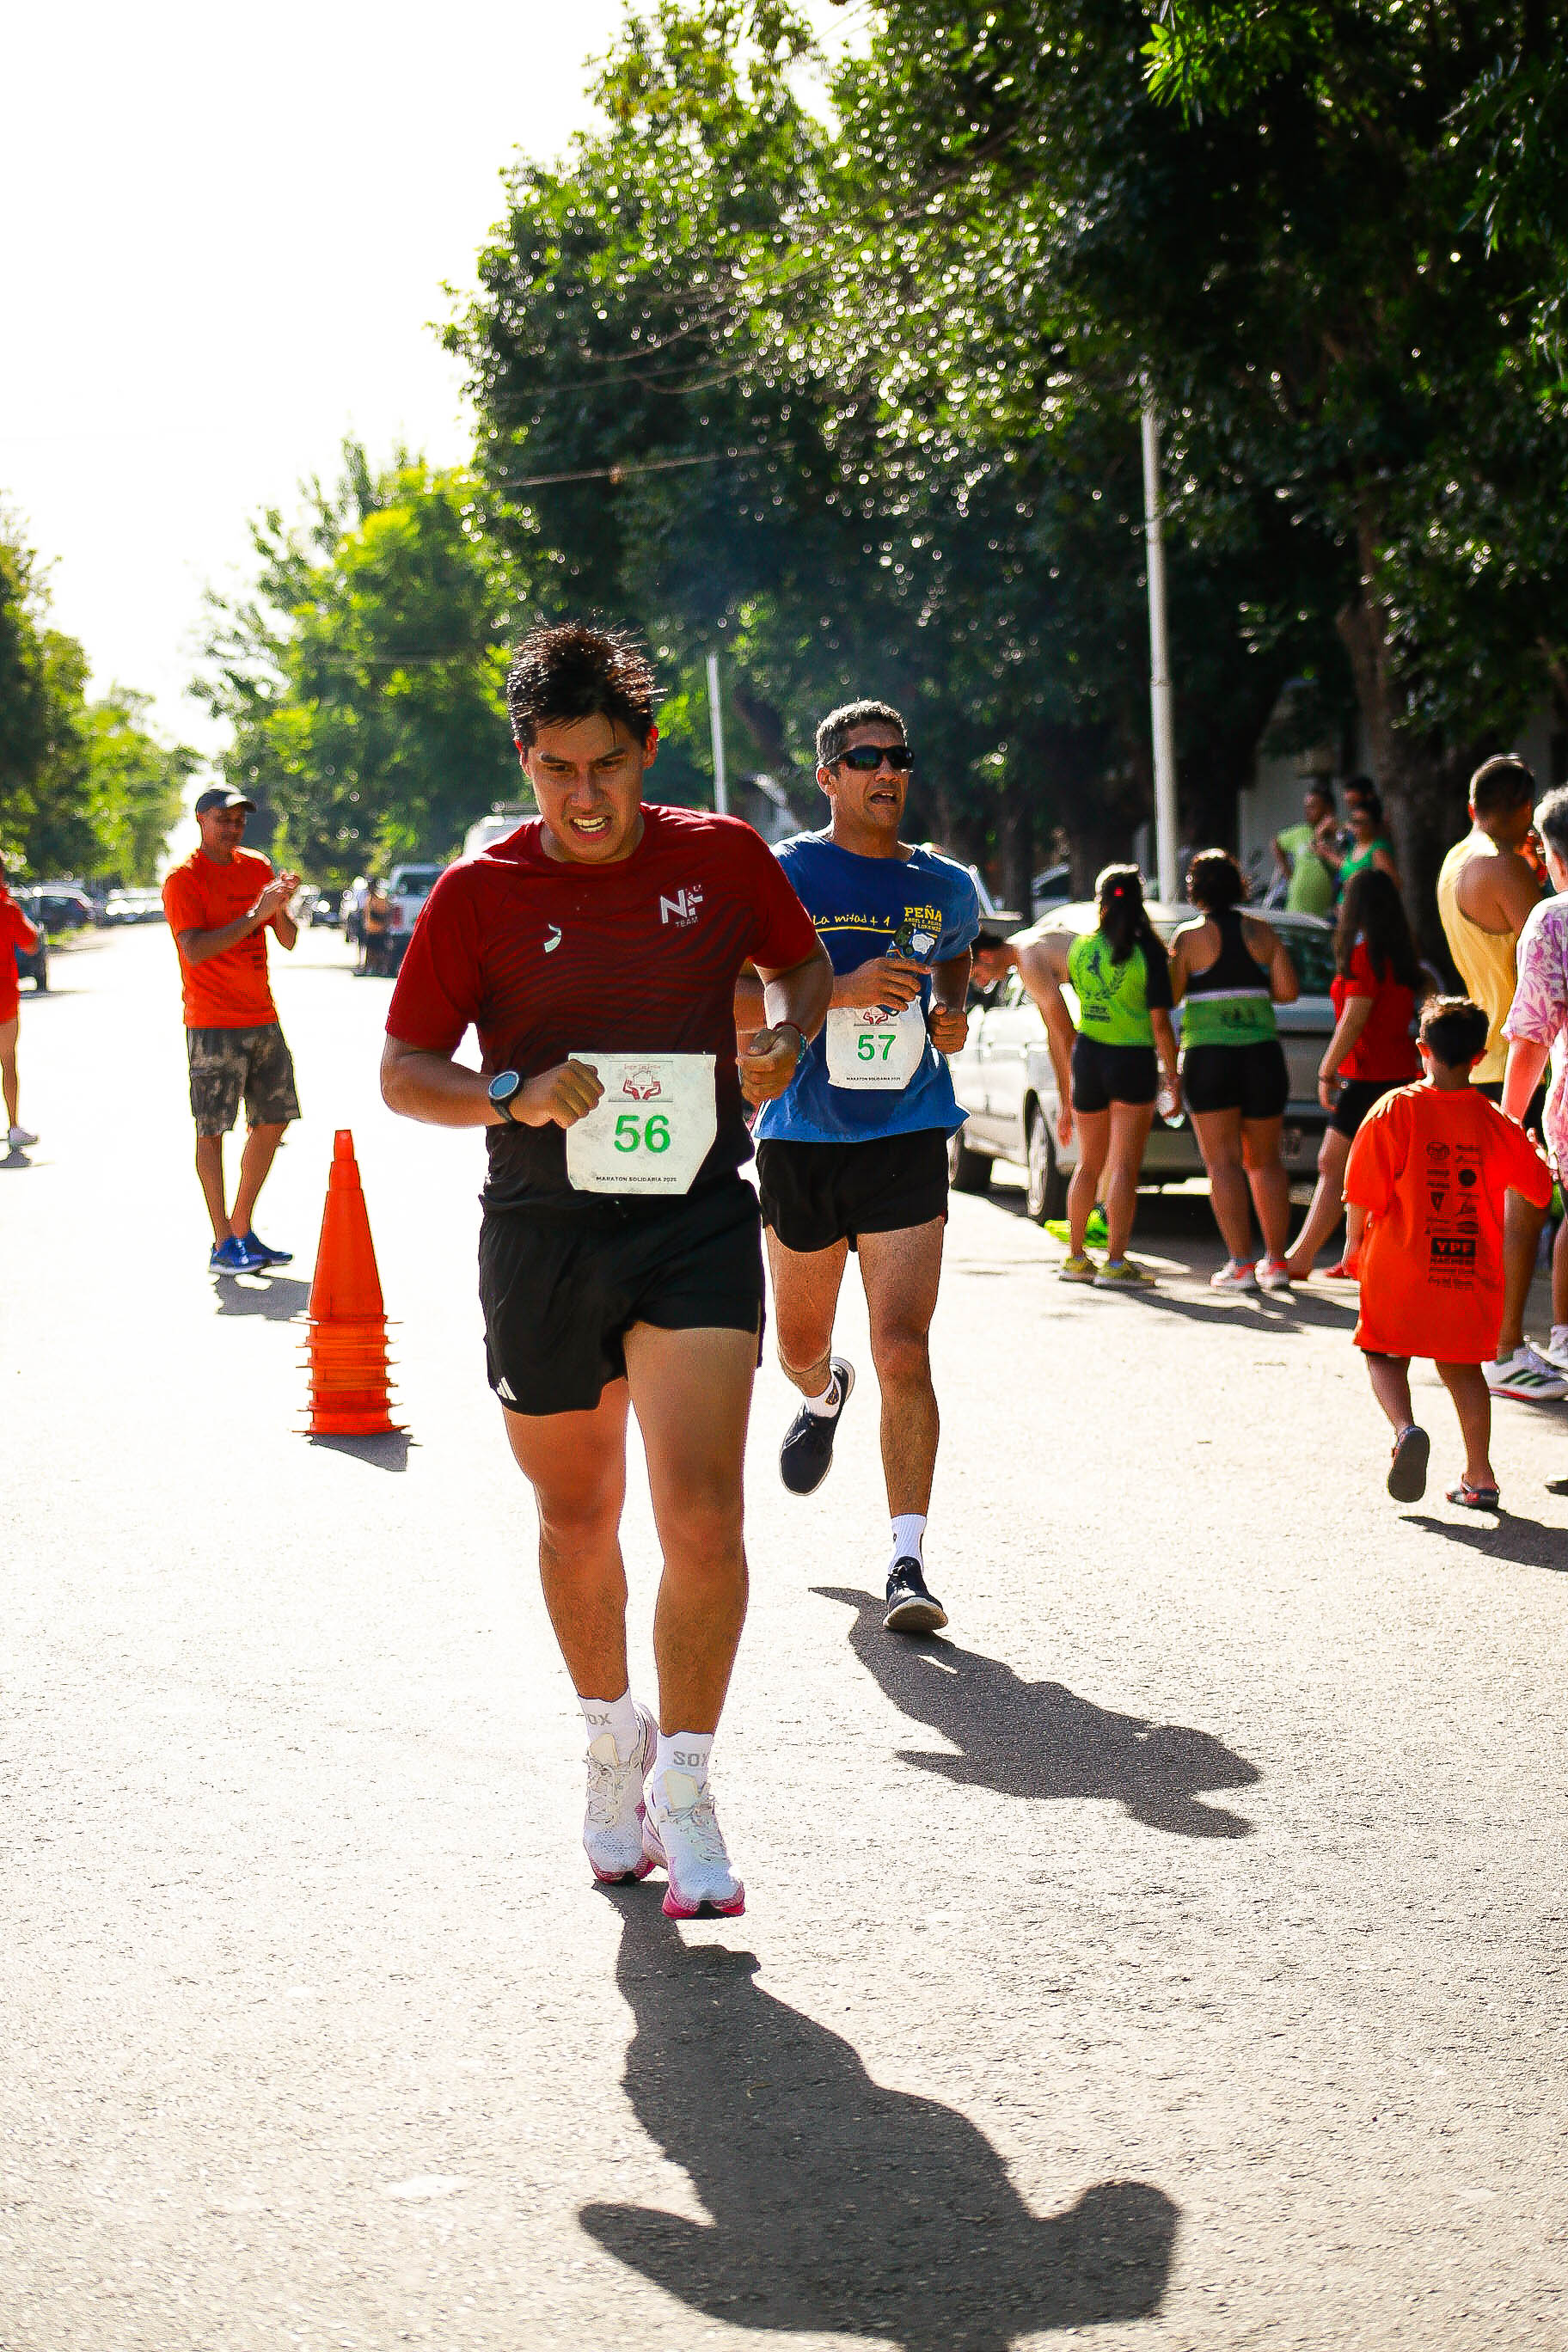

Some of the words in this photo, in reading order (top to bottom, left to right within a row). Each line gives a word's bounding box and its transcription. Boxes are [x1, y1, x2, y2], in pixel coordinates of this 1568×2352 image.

[812, 915, 830, 926] La
[835, 912, 867, 923] mitad
[870, 916, 878, 926] +
[884, 916, 891, 927] 1
[904, 904, 942, 922] PEÑA
[675, 916, 699, 928] TEAM
[857, 1034, 897, 1061] 57
[614, 1115, 671, 1153] 56
[1436, 1240, 1473, 1253] YPF
